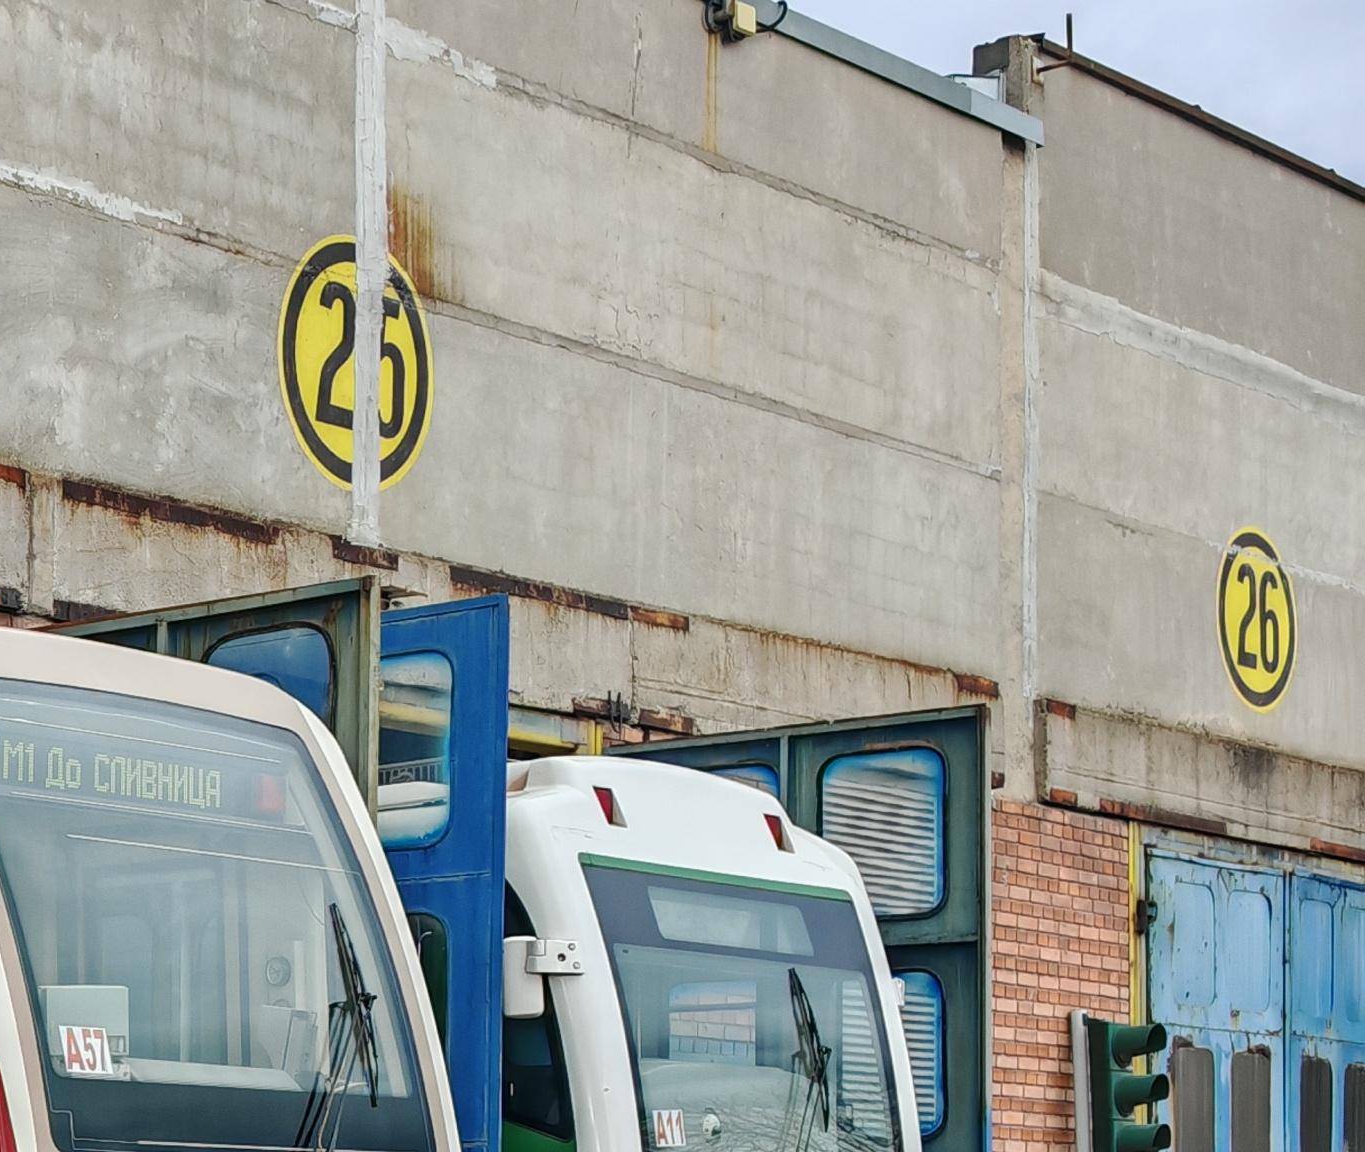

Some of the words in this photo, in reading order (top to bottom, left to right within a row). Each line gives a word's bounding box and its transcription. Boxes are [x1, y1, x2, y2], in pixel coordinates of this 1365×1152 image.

[1237, 563, 1279, 674] 26
[2, 739, 34, 783] М1
[45, 746, 82, 790] До
[93, 753, 221, 808] СЛИВНИЦА
